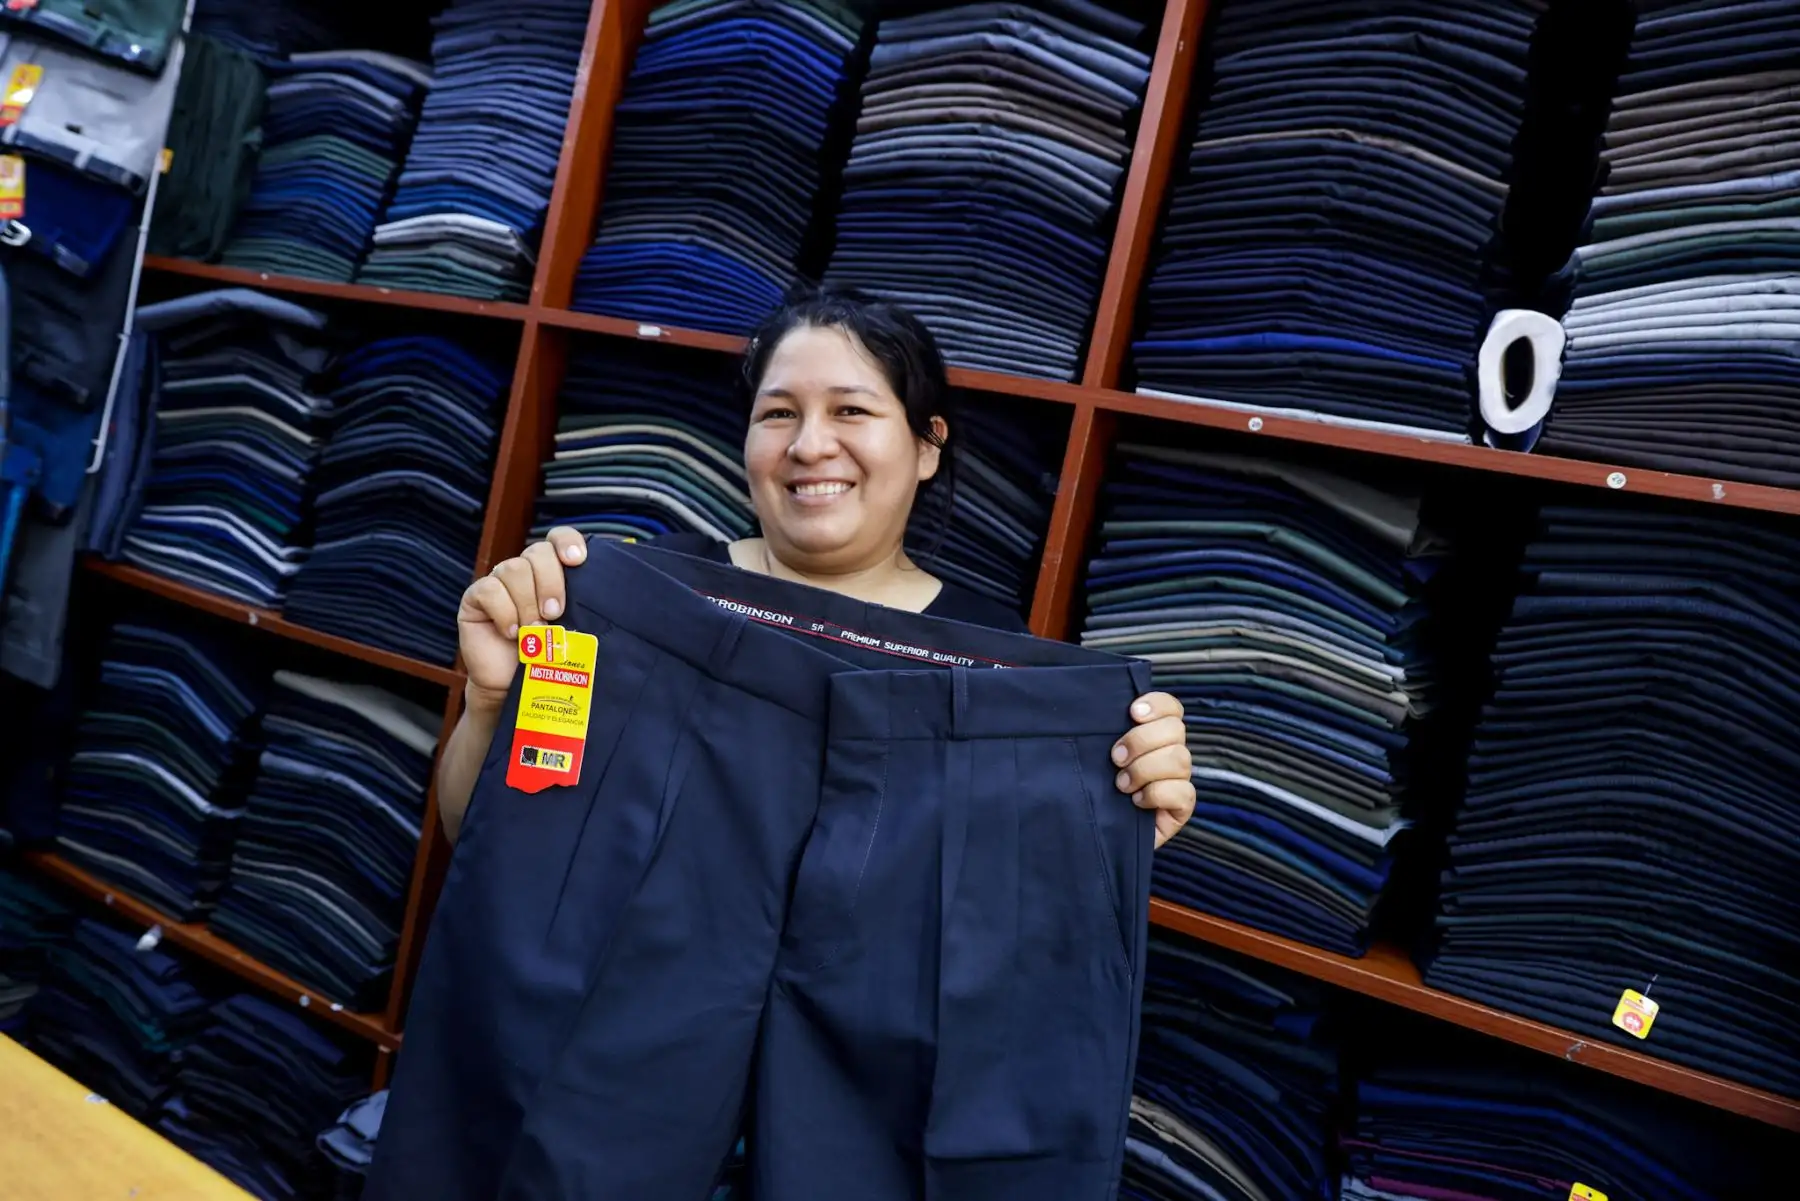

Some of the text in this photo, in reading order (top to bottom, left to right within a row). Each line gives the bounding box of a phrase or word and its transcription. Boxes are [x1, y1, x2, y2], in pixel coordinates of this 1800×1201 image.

[841, 630, 880, 646] PREMIUM
[884, 641, 929, 657] SUPERIOR
[933, 652, 974, 666] QUALITY
[531, 667, 588, 685] MISTER ROBINSON
[531, 702, 578, 716] PANTALONES
[522, 711, 546, 720] CALIDAD
[552, 716, 585, 726] ELEGANCIA
